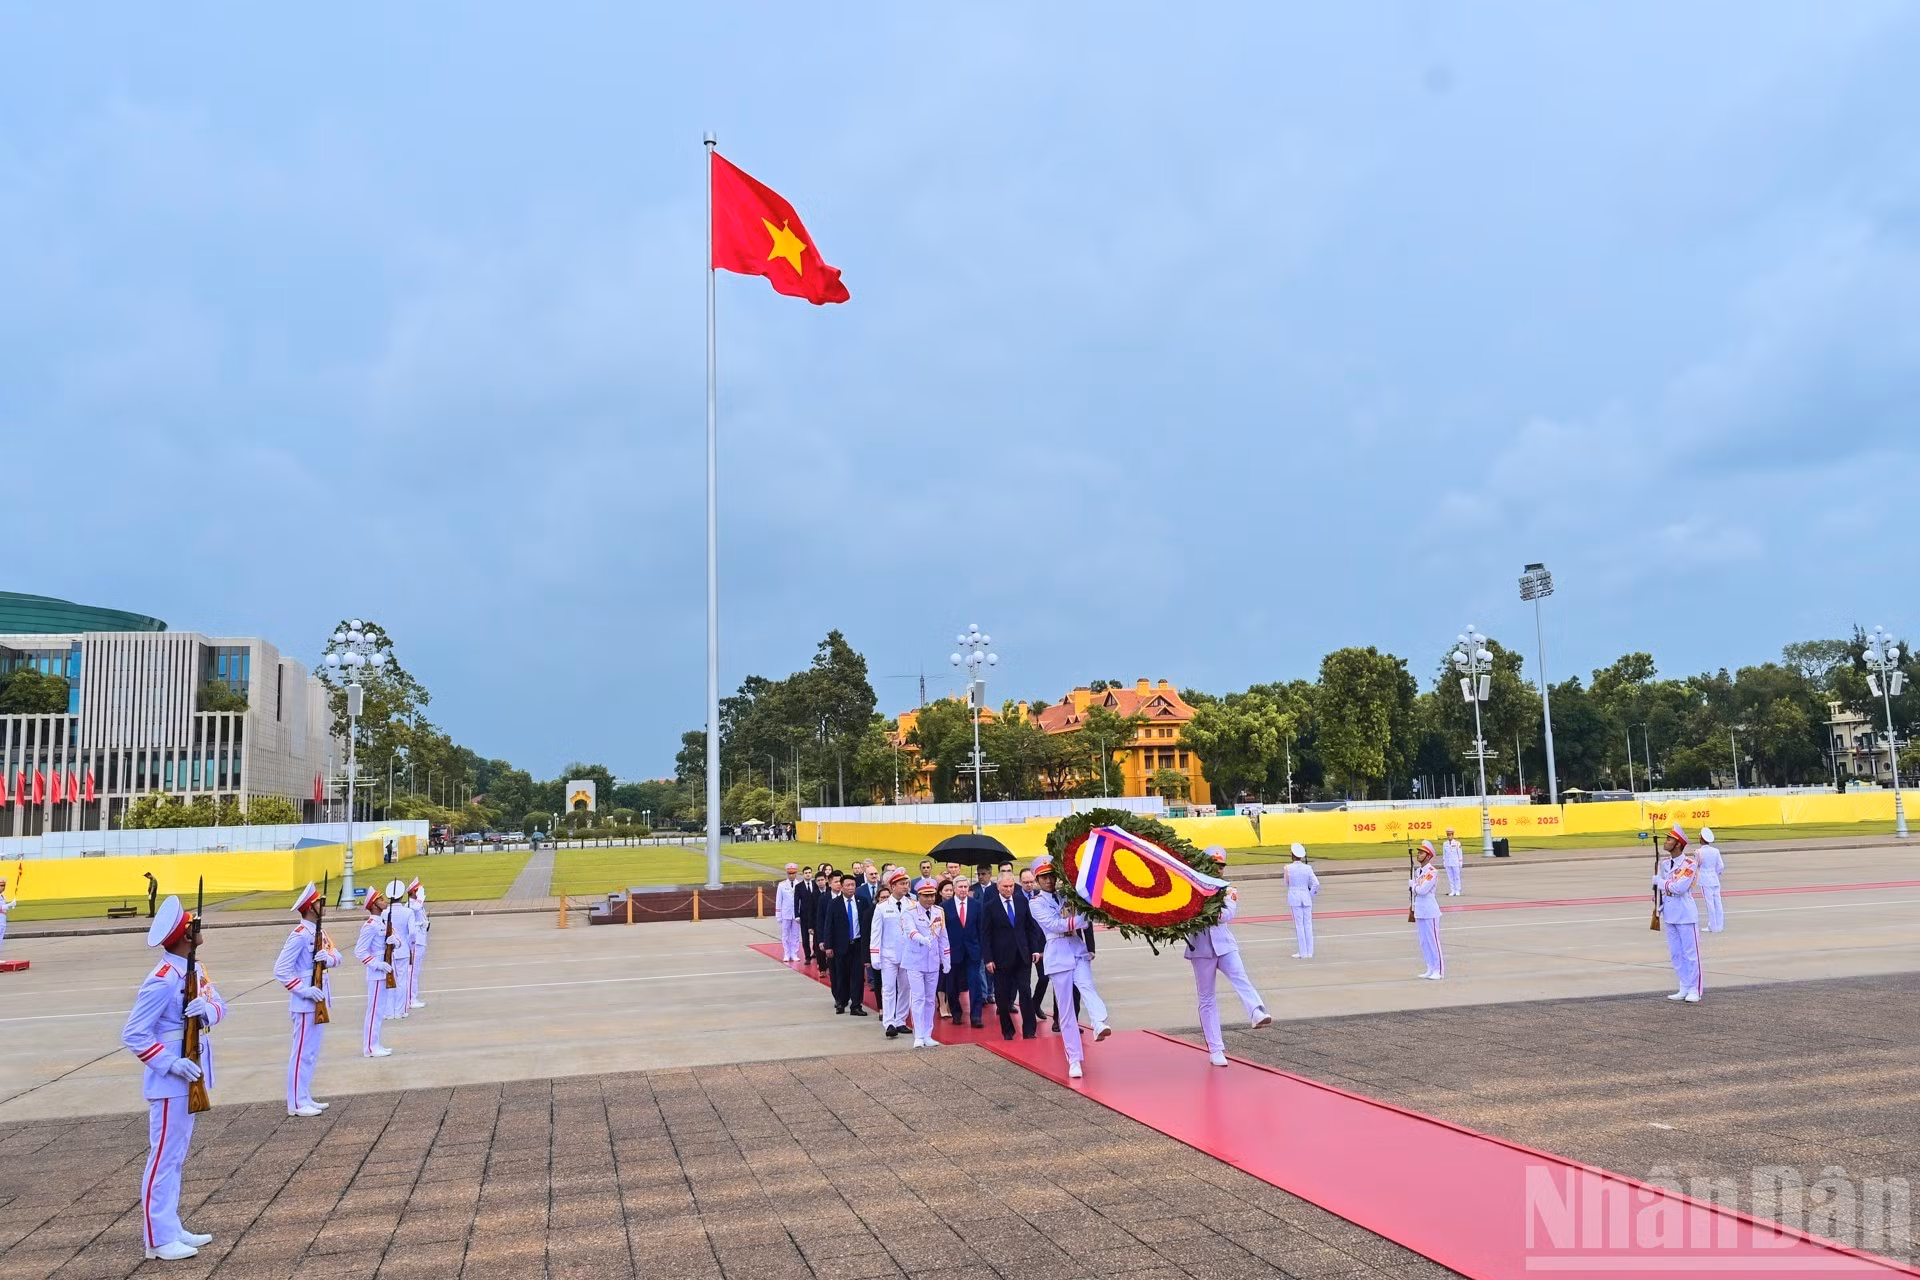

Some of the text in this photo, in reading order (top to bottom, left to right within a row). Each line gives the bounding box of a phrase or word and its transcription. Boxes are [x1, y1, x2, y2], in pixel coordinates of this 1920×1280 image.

[1489, 816, 1559, 826] 945 2025
[1353, 821, 1432, 832] 1945 2025
